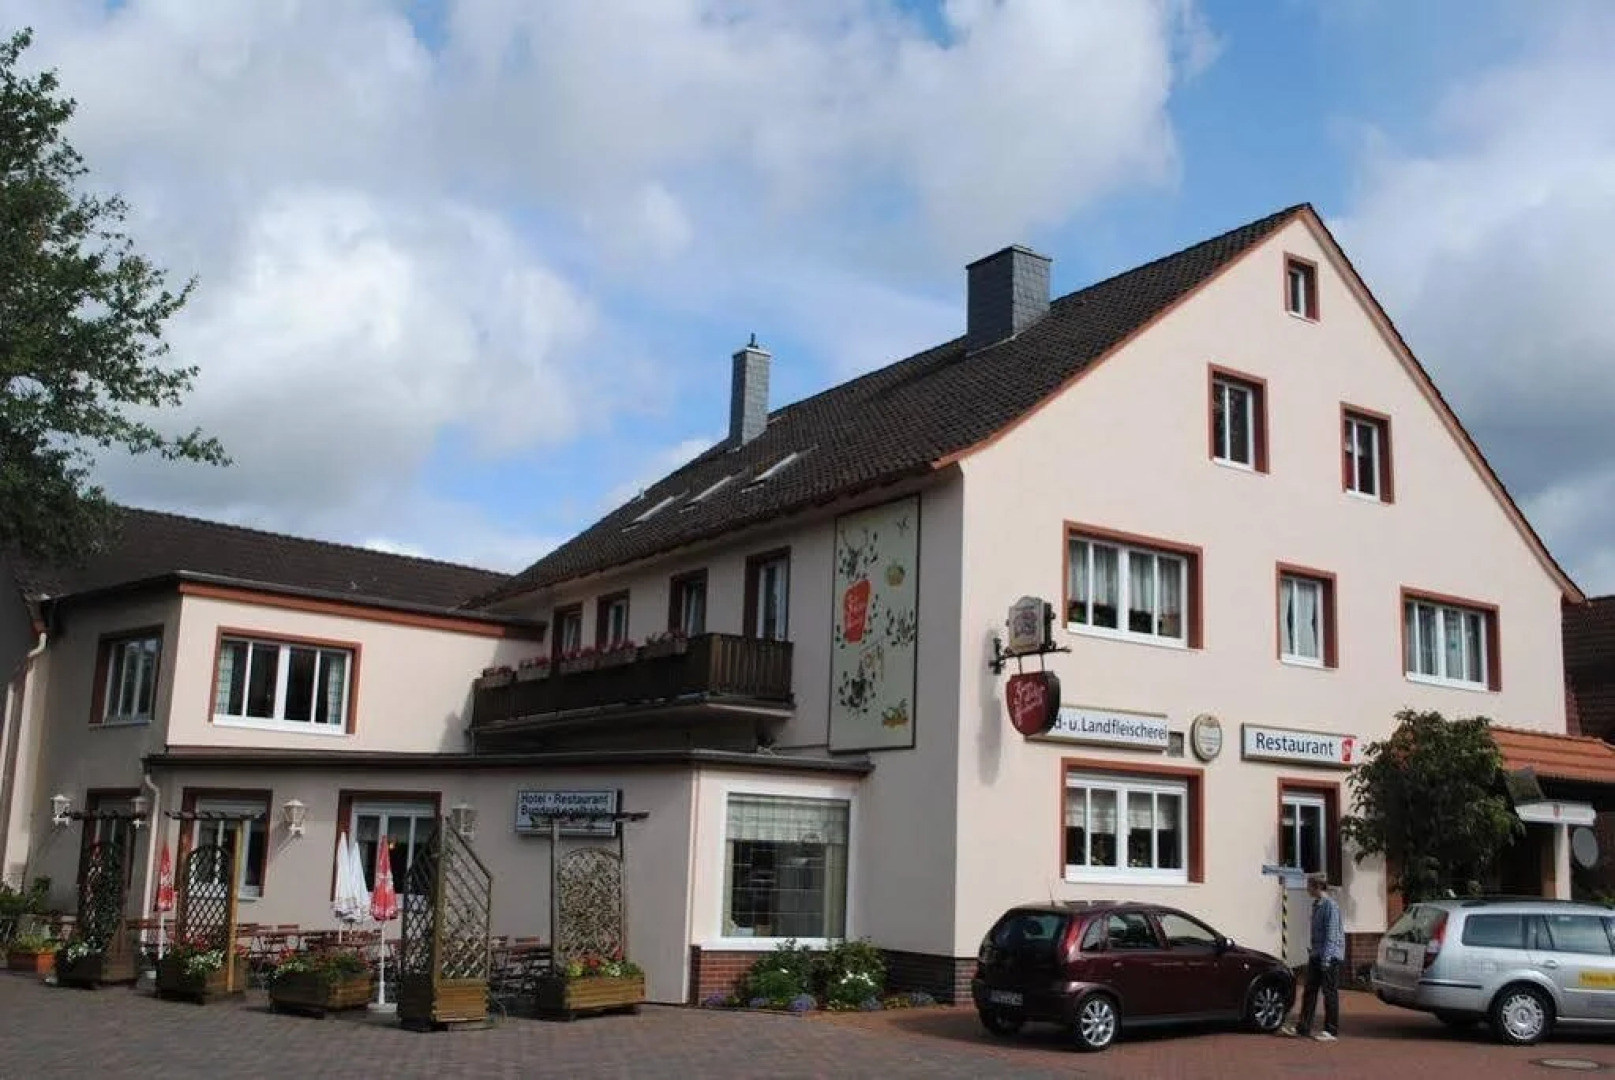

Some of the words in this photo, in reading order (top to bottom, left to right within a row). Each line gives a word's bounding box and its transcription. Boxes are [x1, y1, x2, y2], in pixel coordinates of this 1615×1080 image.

[1256, 732, 1334, 756] Restaurant
[521, 792, 546, 803] Hotel
[554, 793, 609, 805] Restaurant
